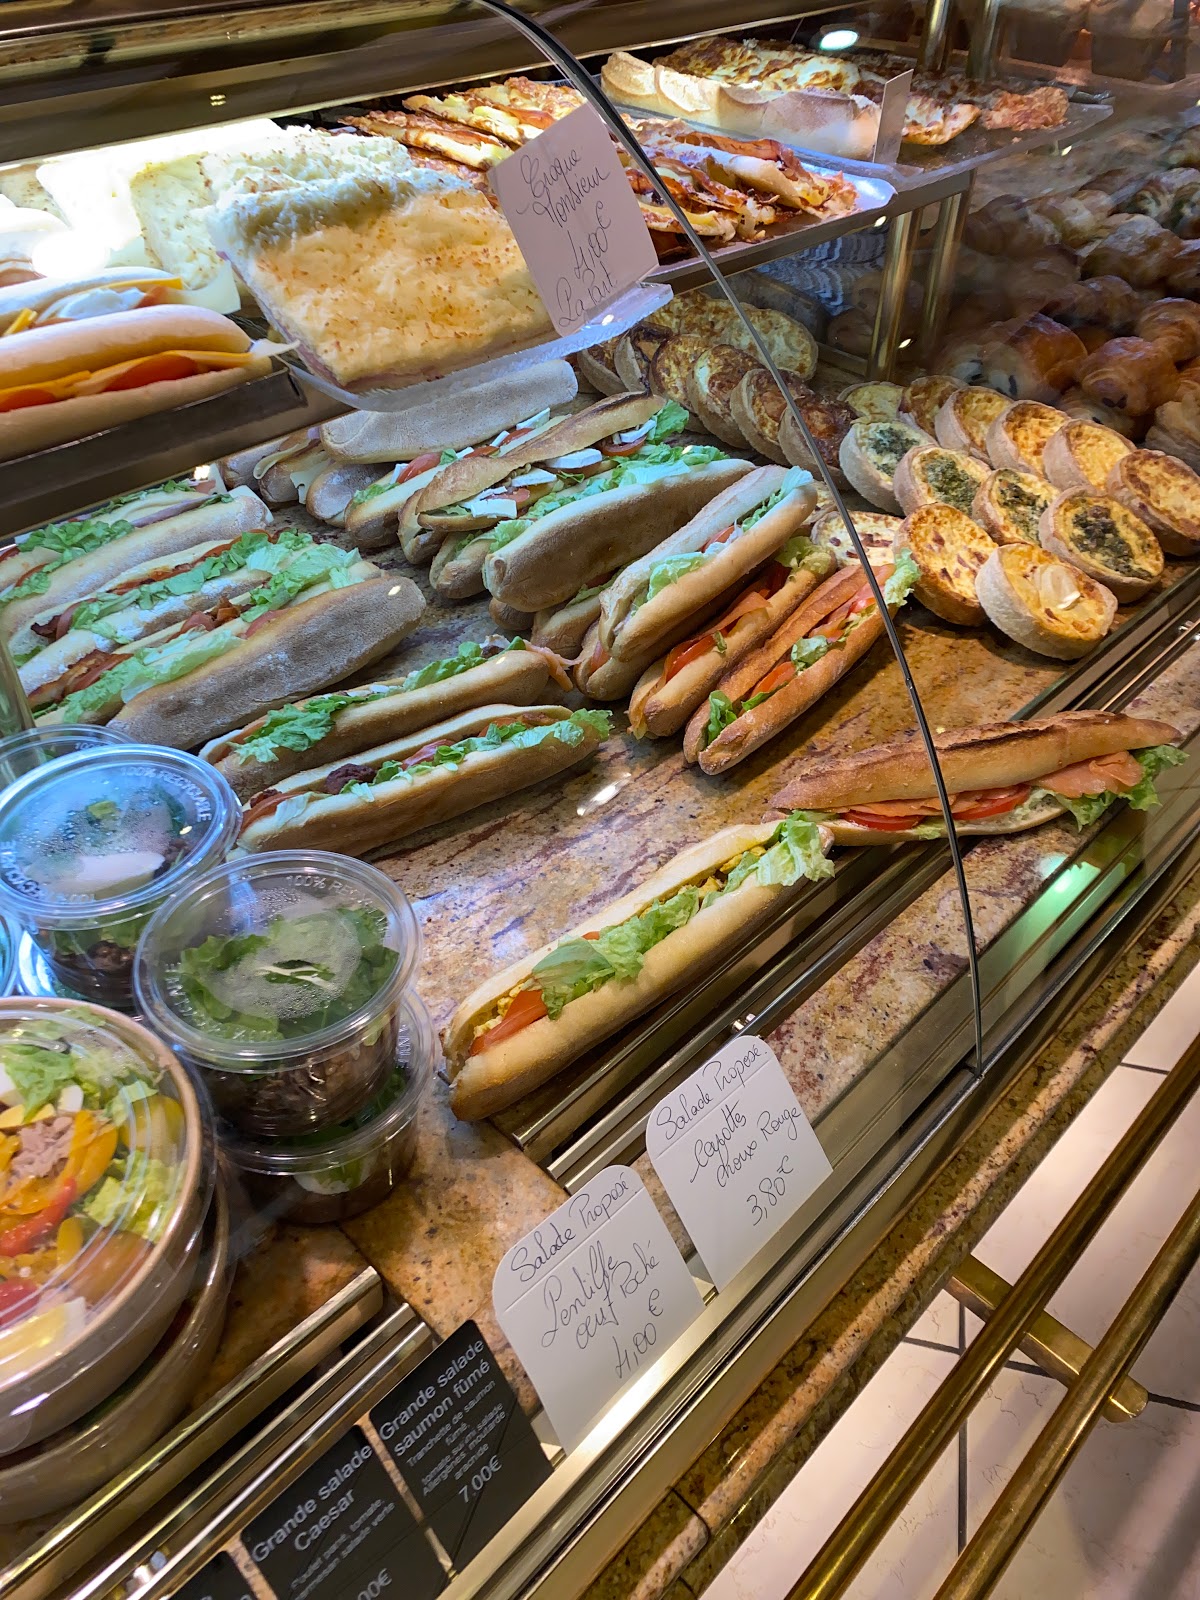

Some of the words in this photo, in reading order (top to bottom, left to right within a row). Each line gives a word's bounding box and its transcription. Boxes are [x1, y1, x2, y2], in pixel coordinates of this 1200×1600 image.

[656, 1084, 713, 1141] Salade
[757, 1107, 801, 1141] Rouge
[510, 1222, 576, 1282] Salade
[379, 1386, 436, 1441] Grande
[437, 1340, 485, 1388] salade
[394, 1396, 454, 1457] saumon
[406, 1423, 451, 1467] Tranchette
[452, 1410, 464, 1425] de
[463, 1380, 496, 1412] saumon
[251, 1498, 317, 1563] Grande
[318, 1445, 373, 1500] salade
[294, 1489, 355, 1551] Caesar
